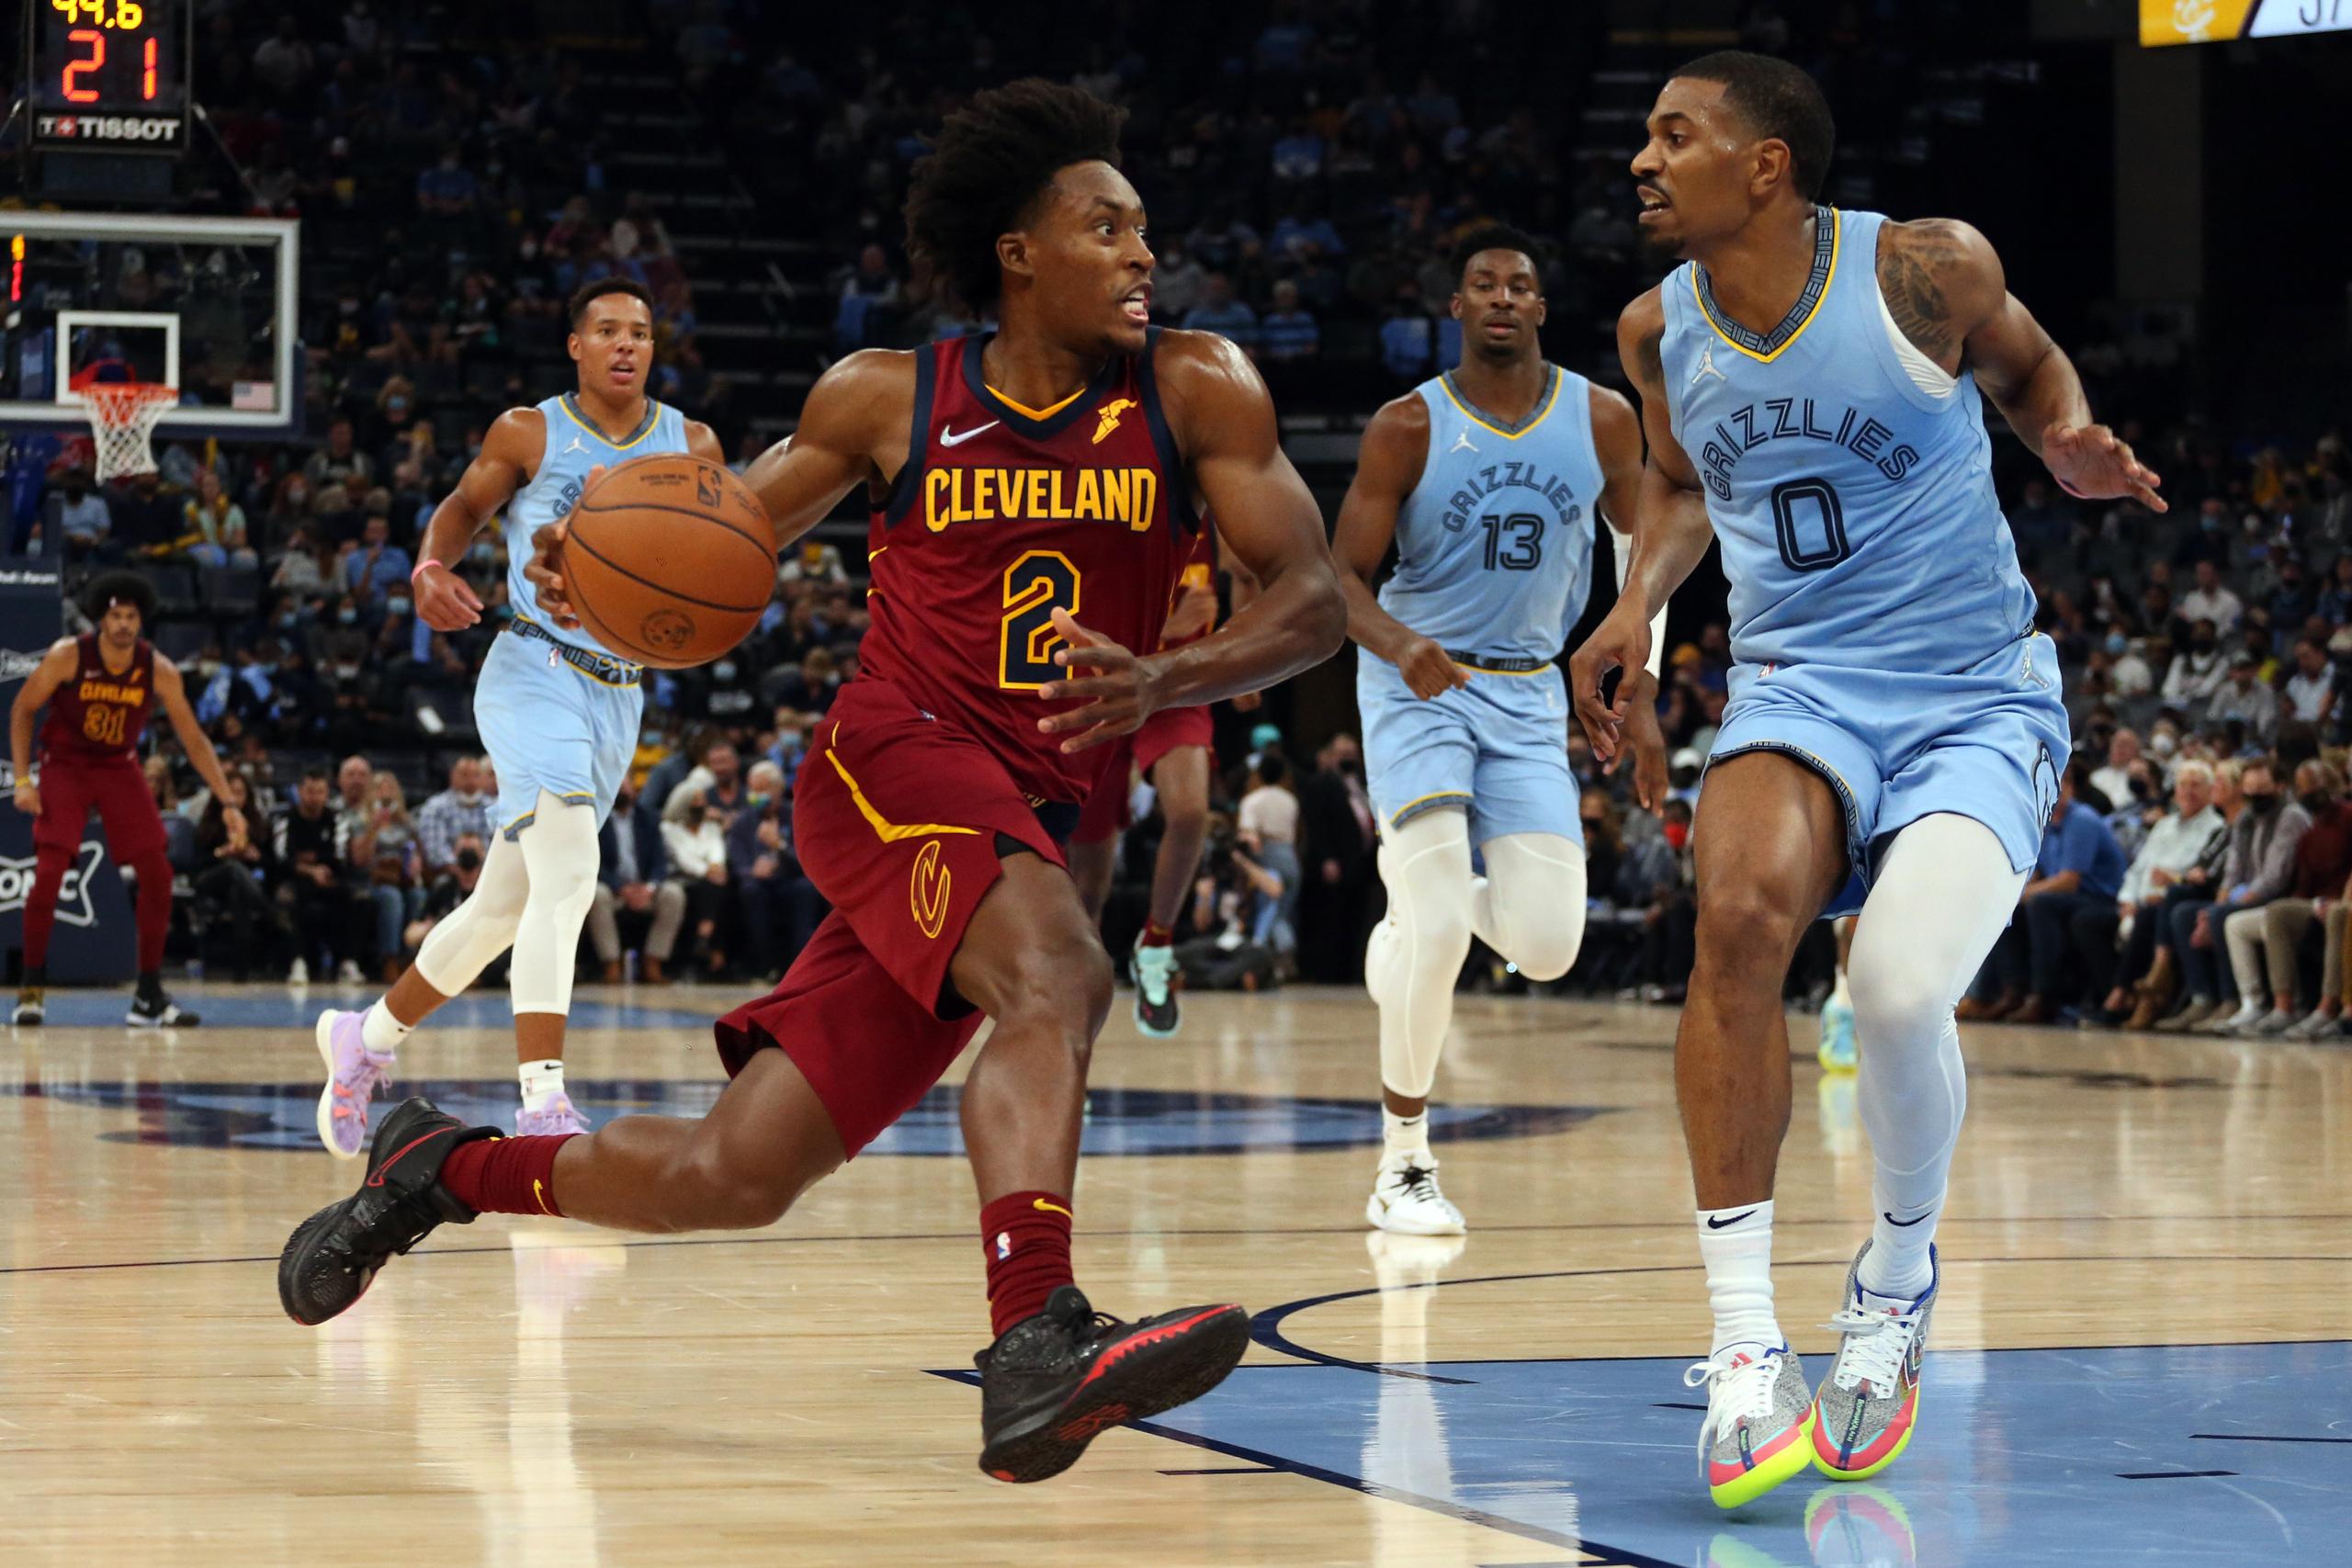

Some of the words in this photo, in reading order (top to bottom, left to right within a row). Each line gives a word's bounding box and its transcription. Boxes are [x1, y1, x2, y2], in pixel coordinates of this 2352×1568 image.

[62, 29, 156, 102] 21
[78, 117, 181, 141] TISSOT
[1702, 398, 1920, 502] GRIZZLIES
[925, 468, 1157, 533] CLEVELAND
[1442, 462, 1581, 533] GRIZZLIES
[1770, 477, 1849, 573] 0
[1480, 513, 1545, 571] 13
[999, 550, 1081, 690] 2
[79, 681, 145, 707] CLEVELAND
[84, 704, 127, 745] 31
